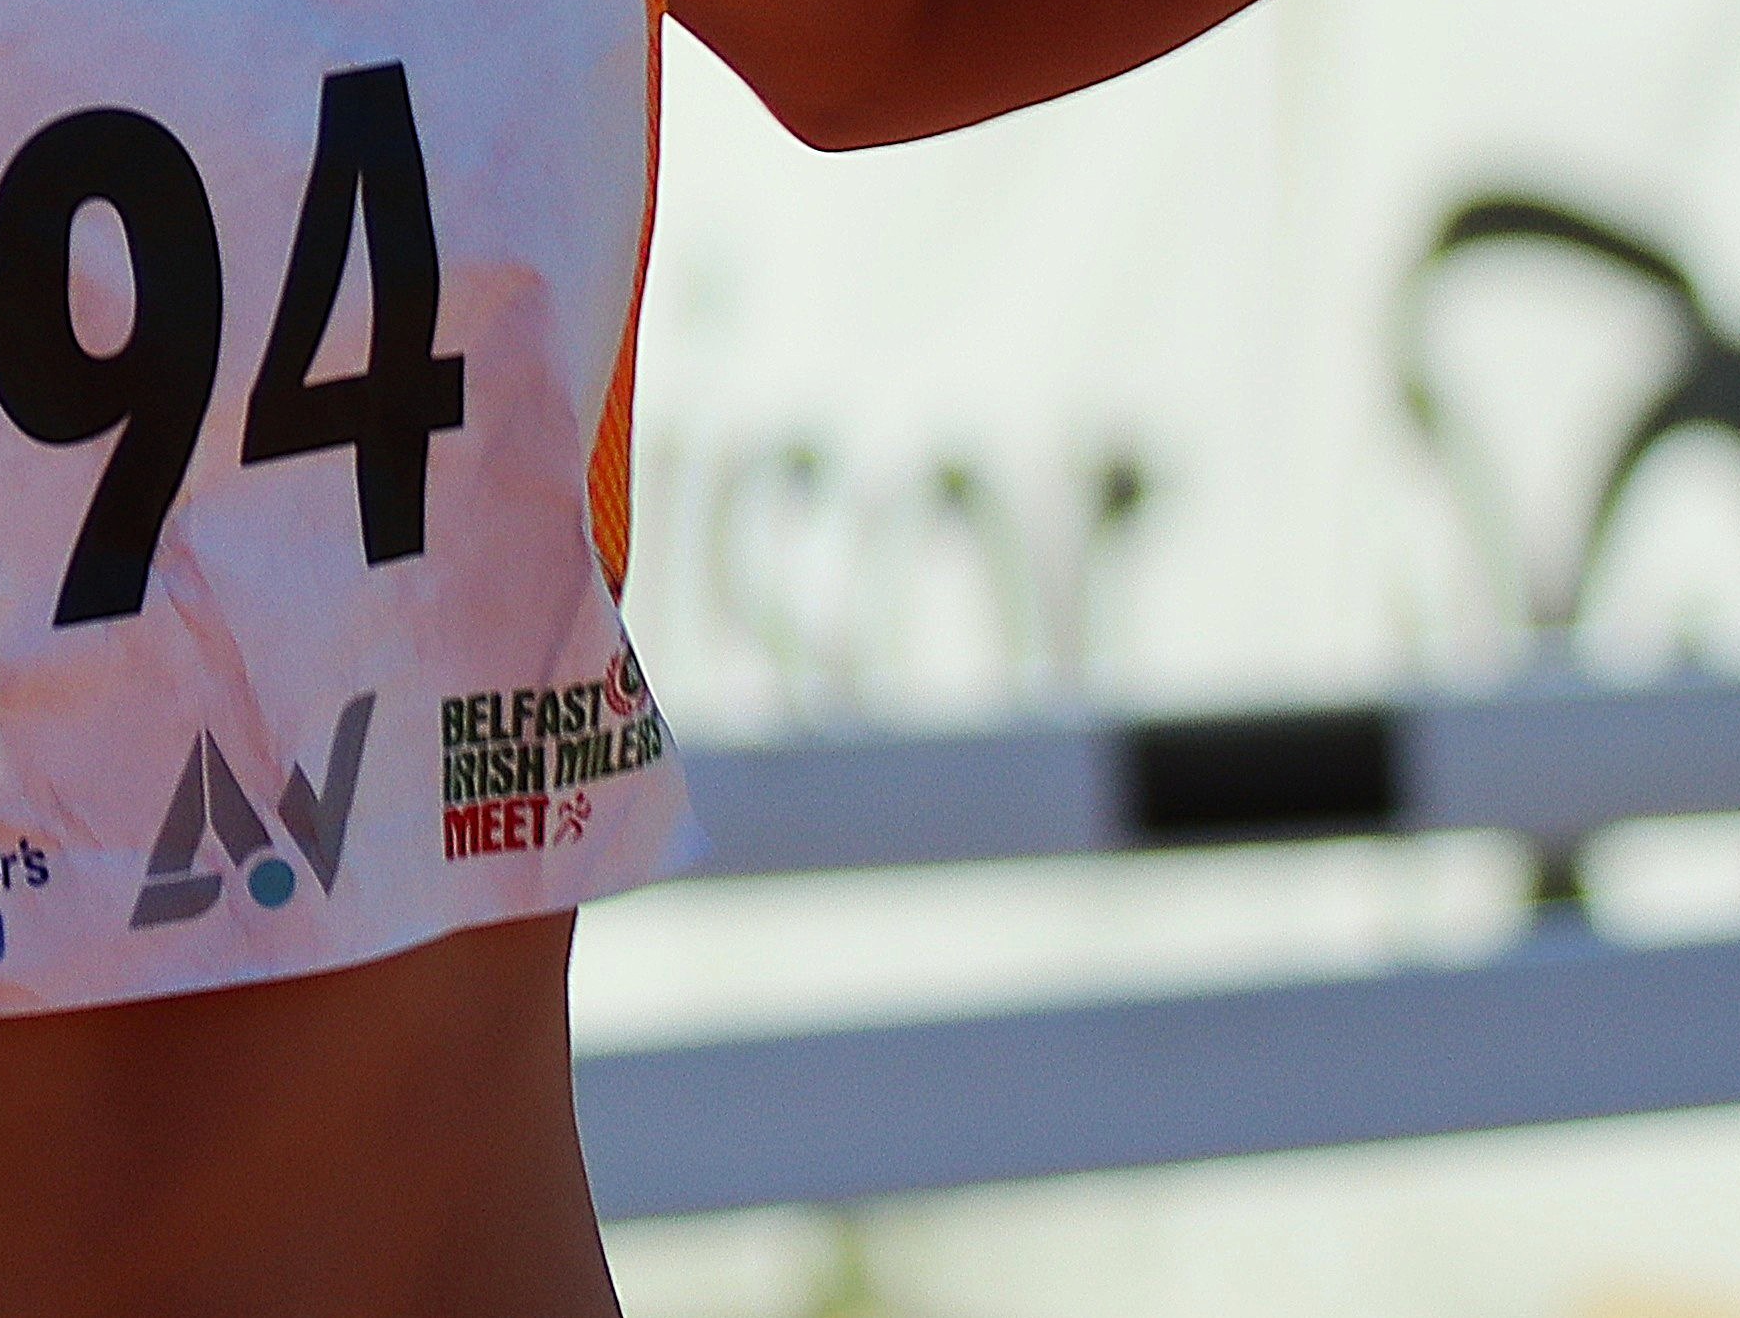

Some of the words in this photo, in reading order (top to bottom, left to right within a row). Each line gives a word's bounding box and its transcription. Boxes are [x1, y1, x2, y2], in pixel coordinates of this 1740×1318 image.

[440, 680, 603, 747] BELFAST
[441, 743, 546, 803] IRISH
[442, 794, 550, 861] MEET
